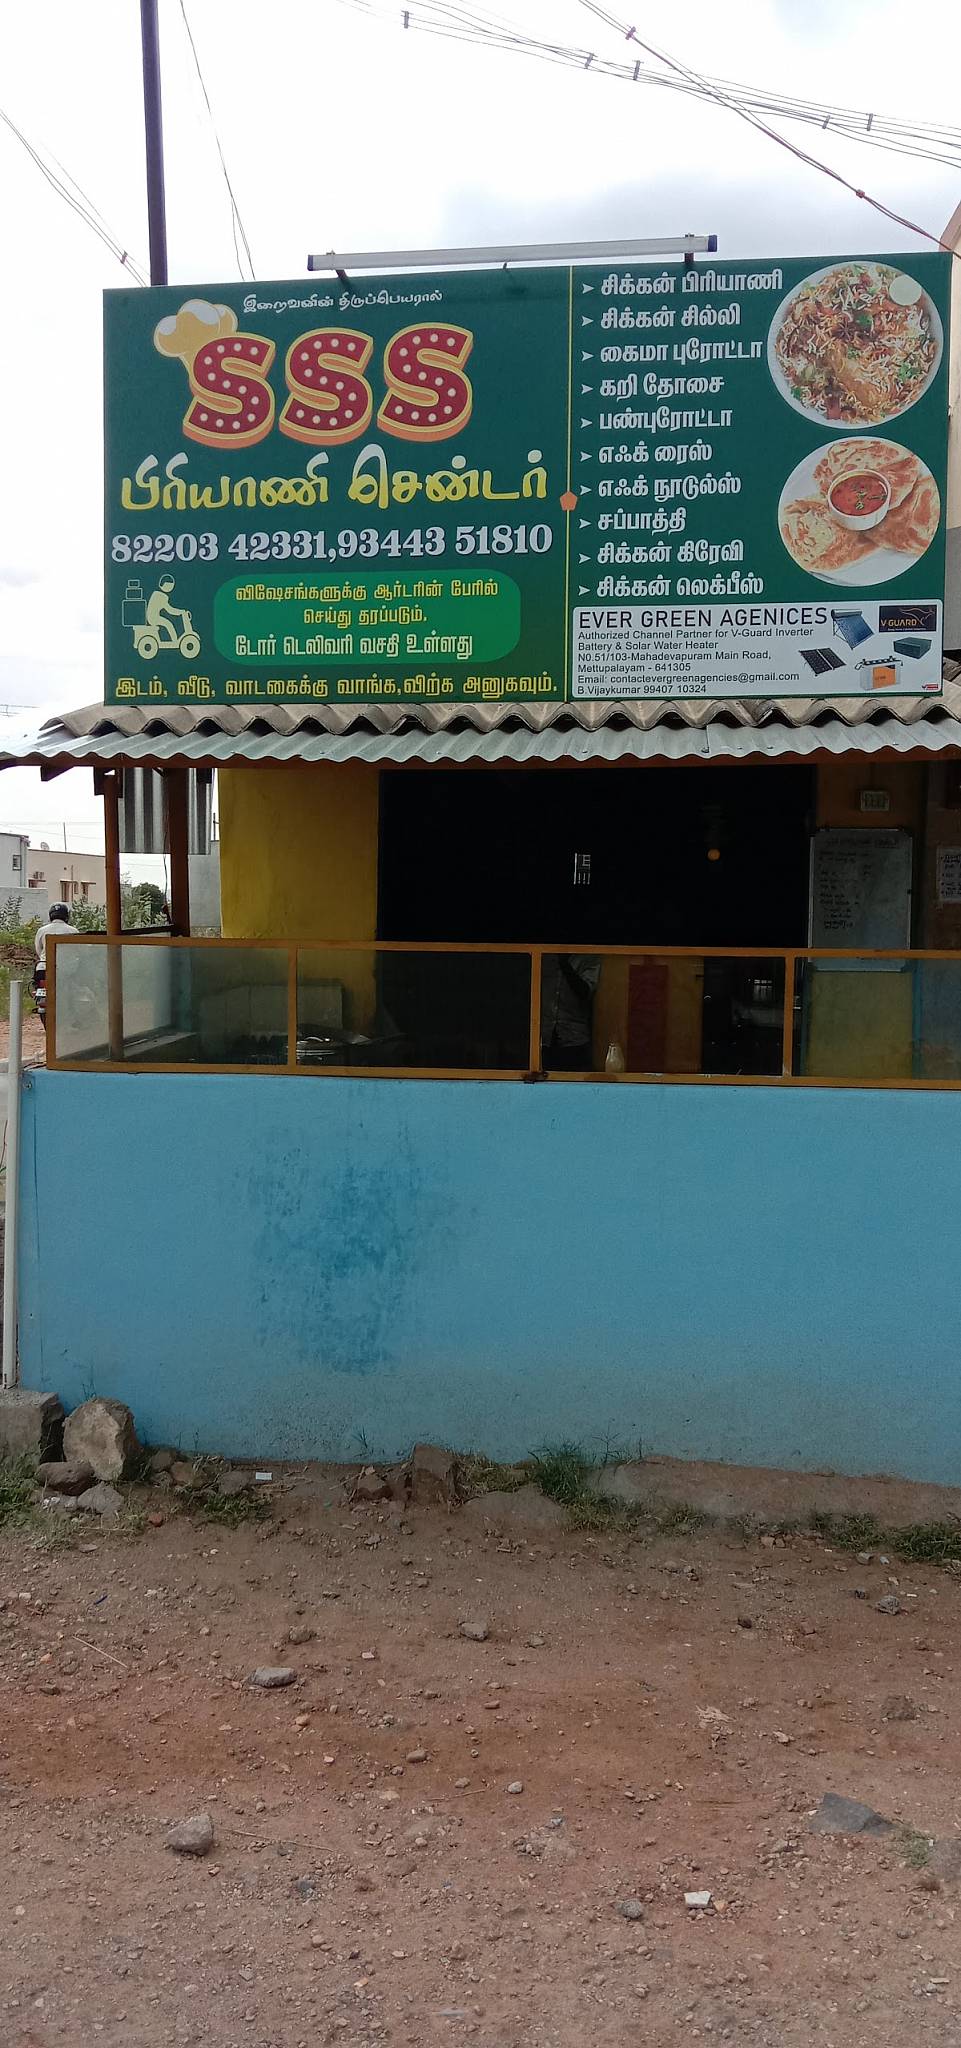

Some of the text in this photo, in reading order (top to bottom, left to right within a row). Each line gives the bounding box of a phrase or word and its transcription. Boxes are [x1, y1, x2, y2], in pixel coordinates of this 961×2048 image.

[601, 268, 783, 296] சிக்கன் பிரியாணி
[243, 289, 442, 313] இறைவனின் திருப்பெயரால்
[600, 302, 741, 329] சிக்கன் சில்லி
[600, 337, 763, 365] கைமா புரோட்டா
[183, 322, 473, 449] SSS
[599, 372, 725, 402] கறி தோசை
[598, 438, 713, 465] எஃக் ரைஸ்
[121, 451, 329, 511] பிரியாணி
[598, 471, 742, 503] எஃக் நூடுல்ஸ்
[597, 507, 687, 536] சப்பாத்தி
[111, 533, 219, 563] 82203
[455, 524, 553, 555] 51810
[597, 539, 744, 565] சிக்கன் கிரேவி
[235, 578, 498, 603] விஷேசங்களுக்கு ஆர்டரின் பேரில்
[596, 571, 764, 597] சிக்கன் லெக்பீஸ்
[304, 604, 427, 629] செய்து தரப்படும்.
[579, 607, 828, 629] EVER GREEN AGENICES
[235, 630, 473, 660] டோர் டெலிவரி வசதி உள்ளது
[578, 628, 814, 640] Authorized Channel Partner for V-Guard Inverter
[578, 640, 719, 652] Battery & Solar Water Heater
[577, 664, 645, 674] Mettupalayam
[655, 663, 691, 672] 641305
[715, 651, 739, 660] Main
[742, 650, 771, 661] Road,
[115, 675, 168, 698] இடம்,
[177, 675, 216, 698] வீடு,
[225, 674, 328, 697] வாடகைக்கு
[463, 671, 558, 698] அனுகவும்.
[577, 684, 706, 696] B.Vijaykumar 99407 10324
[578, 675, 607, 684] Email:
